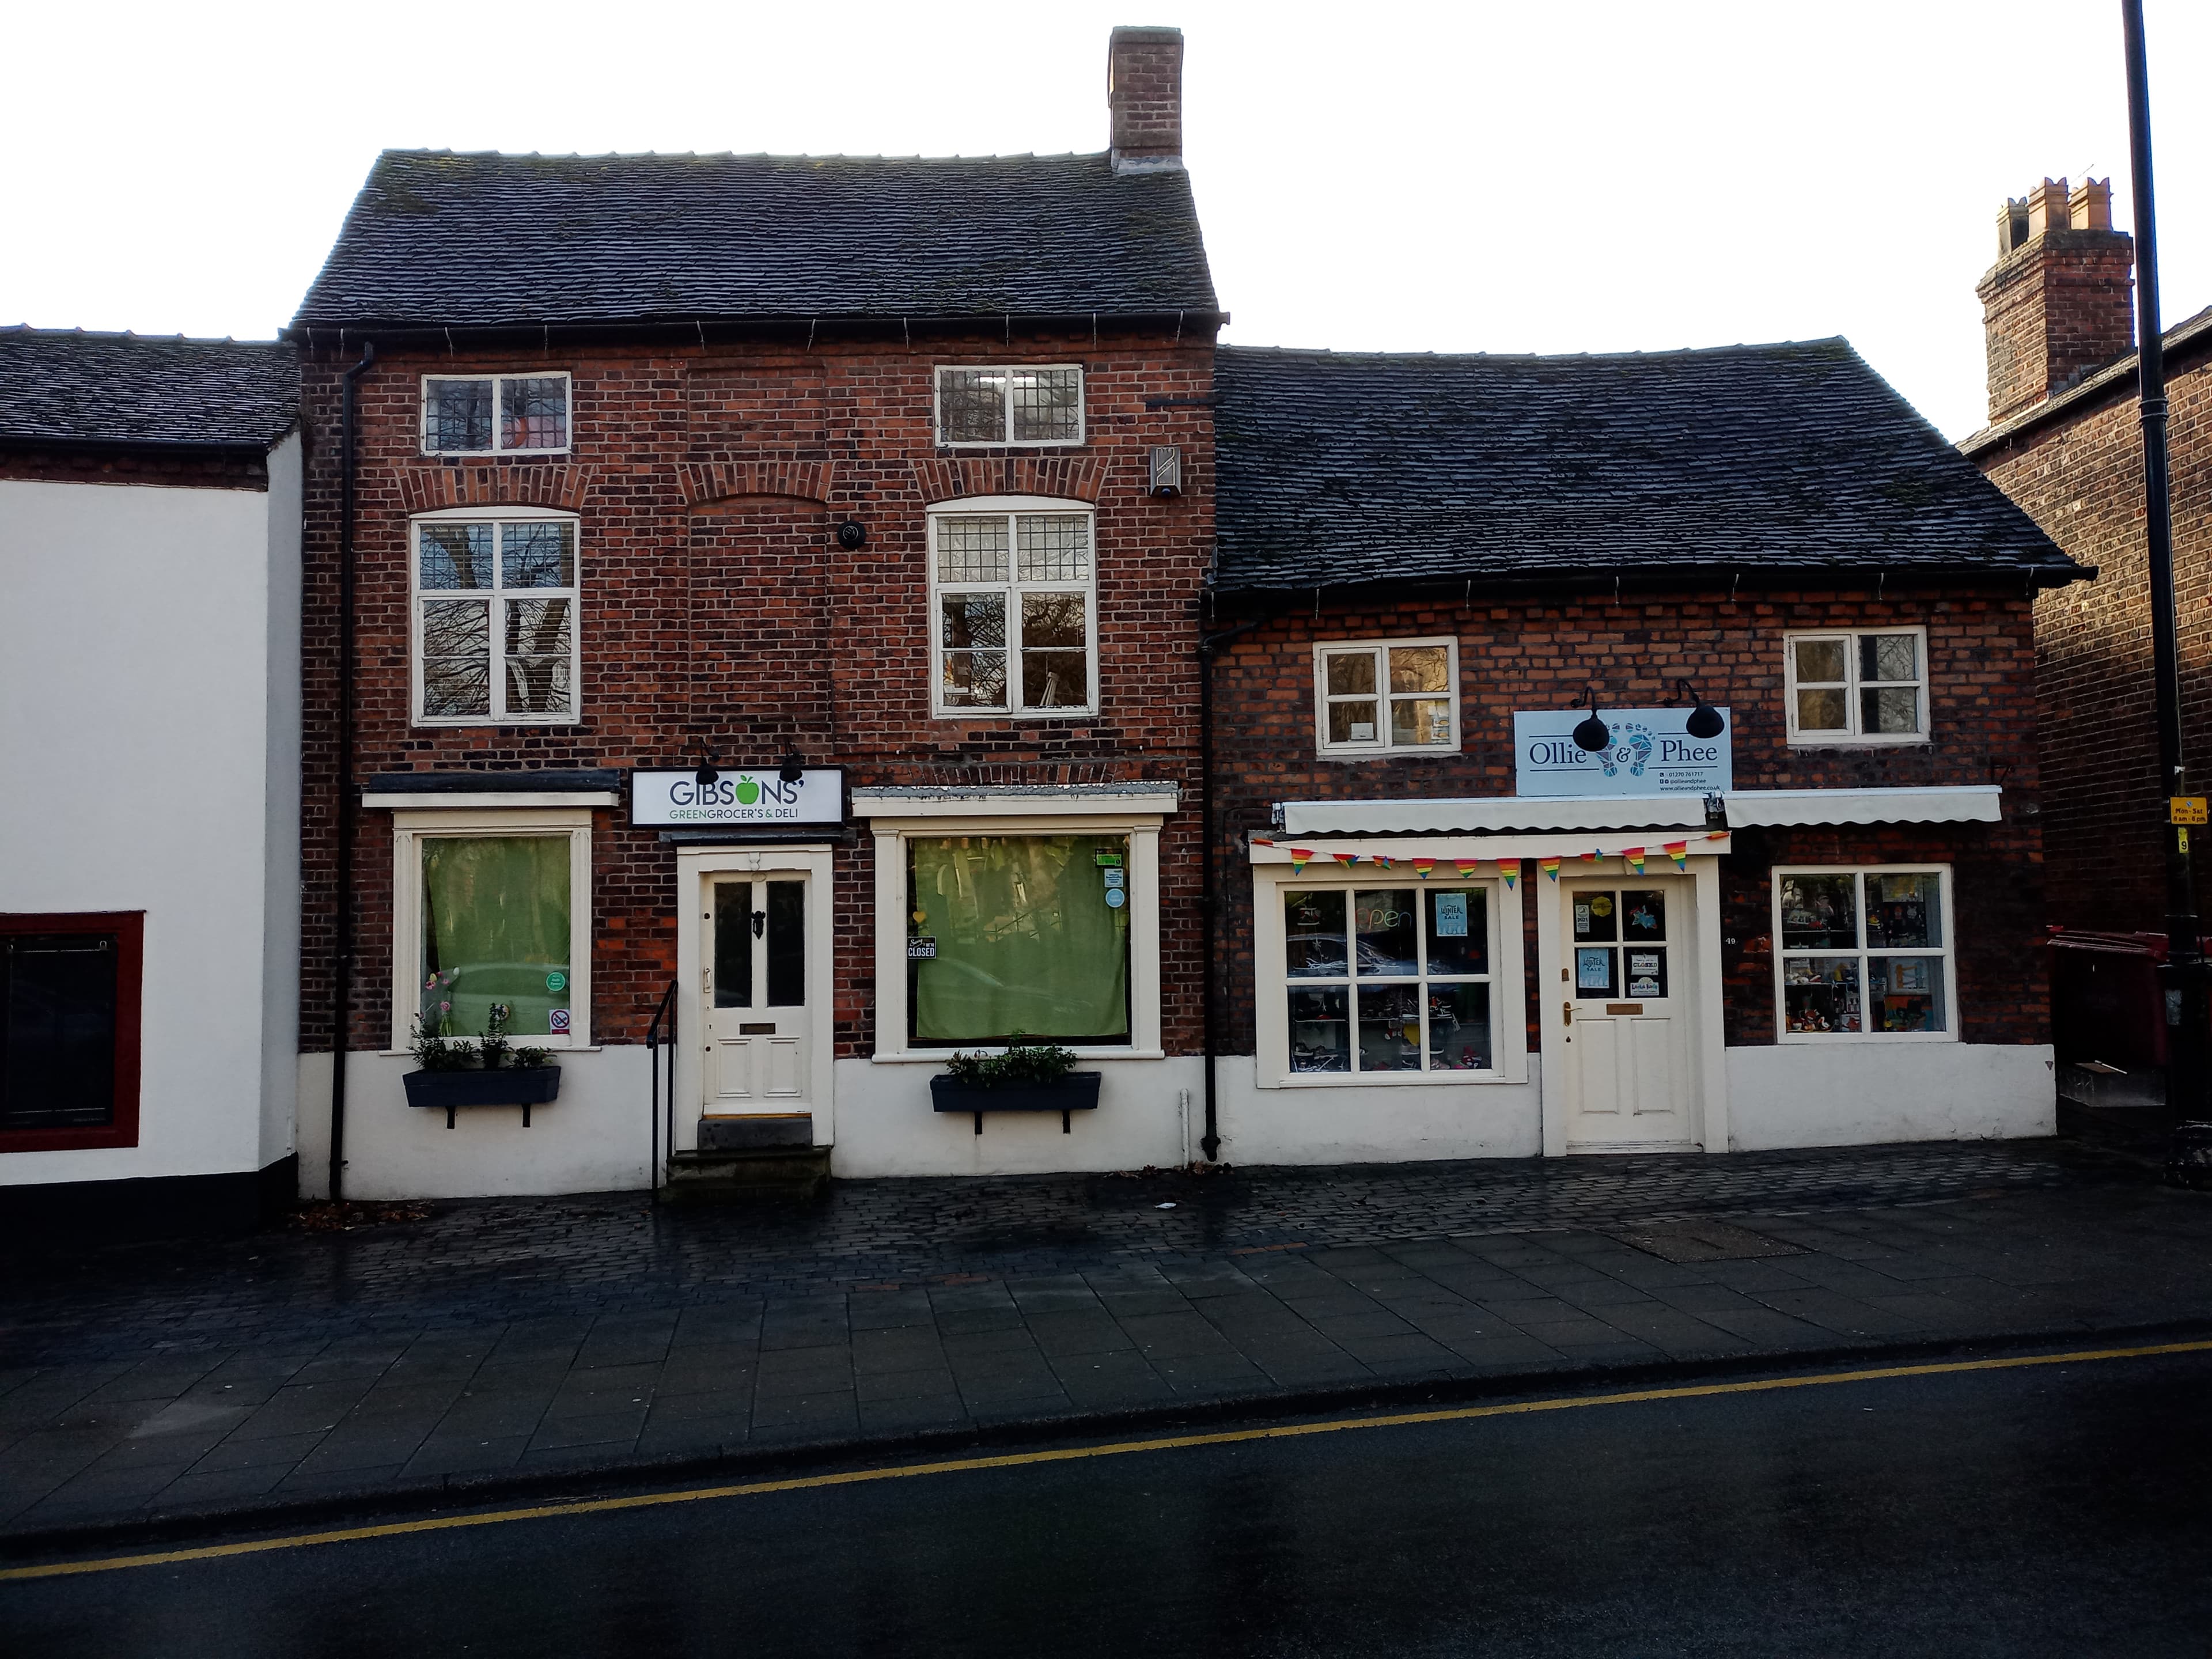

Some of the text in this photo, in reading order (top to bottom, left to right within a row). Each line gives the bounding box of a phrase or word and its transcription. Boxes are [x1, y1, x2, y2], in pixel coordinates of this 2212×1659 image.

[1529, 740, 1718, 764] Ollie & Phee
[669, 808, 798, 819] GREENGROCER'S & DELI
[2181, 841, 2187, 850] 9
[908, 948, 934, 956] CLOSED
